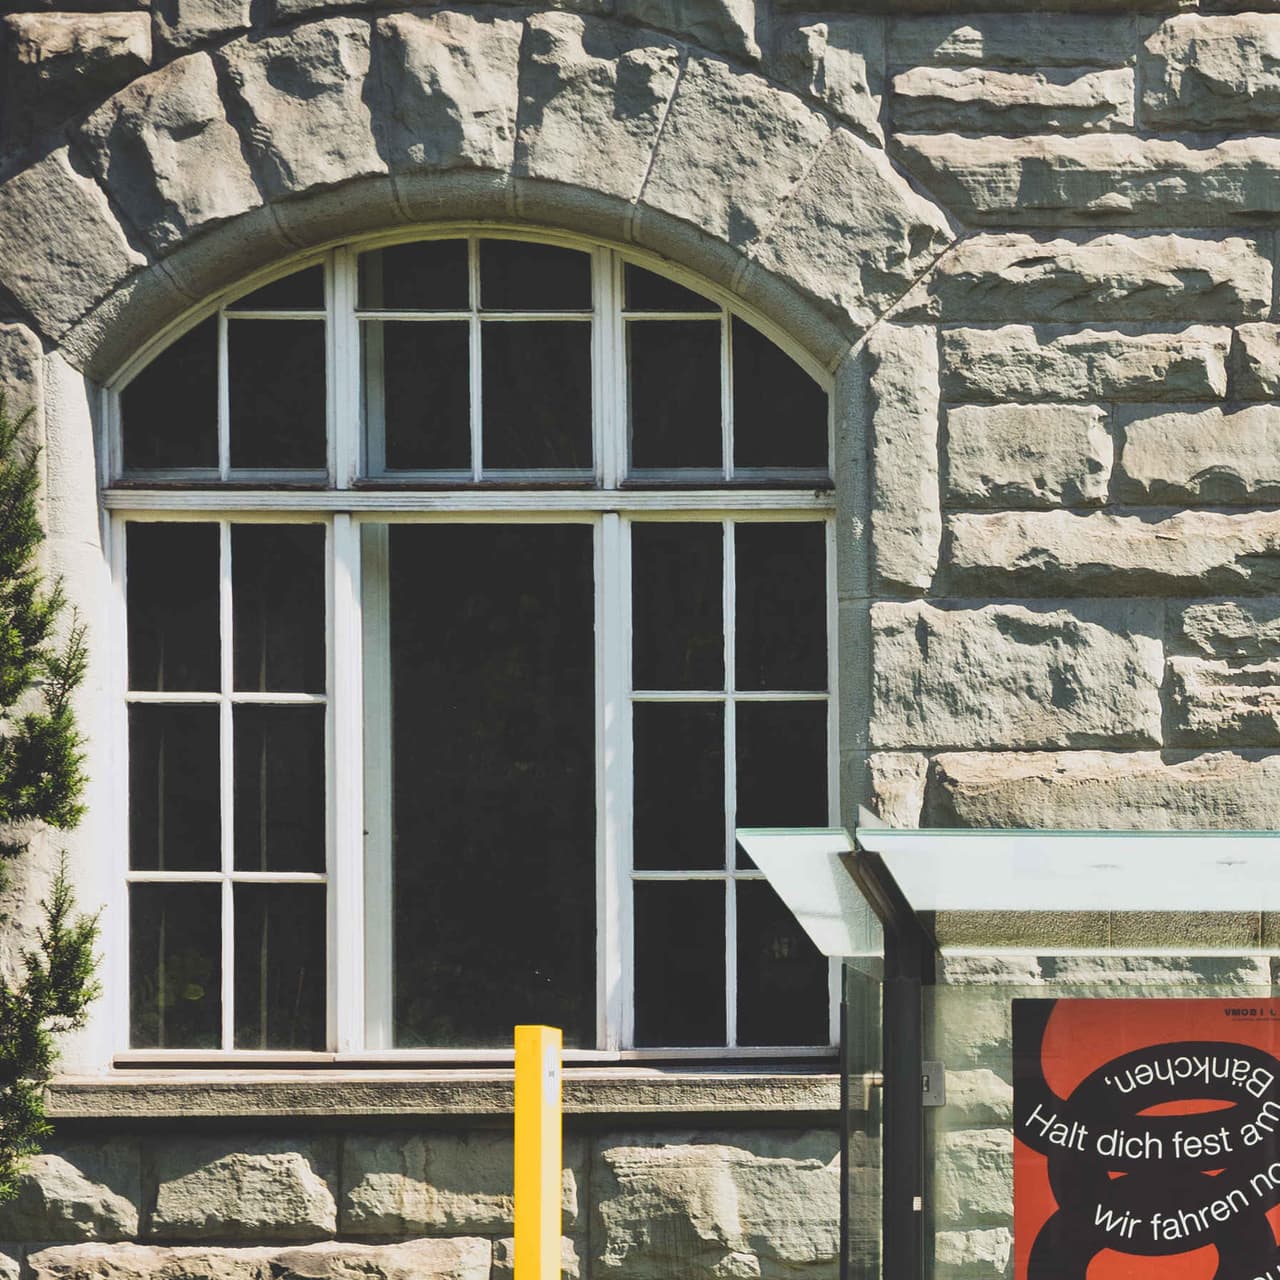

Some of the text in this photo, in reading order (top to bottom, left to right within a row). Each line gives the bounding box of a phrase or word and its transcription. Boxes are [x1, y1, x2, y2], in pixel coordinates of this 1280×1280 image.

[1105, 1057, 1274, 1098] Bänkchen,
[1026, 1104, 1088, 1151] Halt
[1097, 1129, 1162, 1159] dich
[1172, 1128, 1233, 1158] fest
[1095, 1204, 1141, 1238] wir
[1150, 1190, 1249, 1240] fahren
